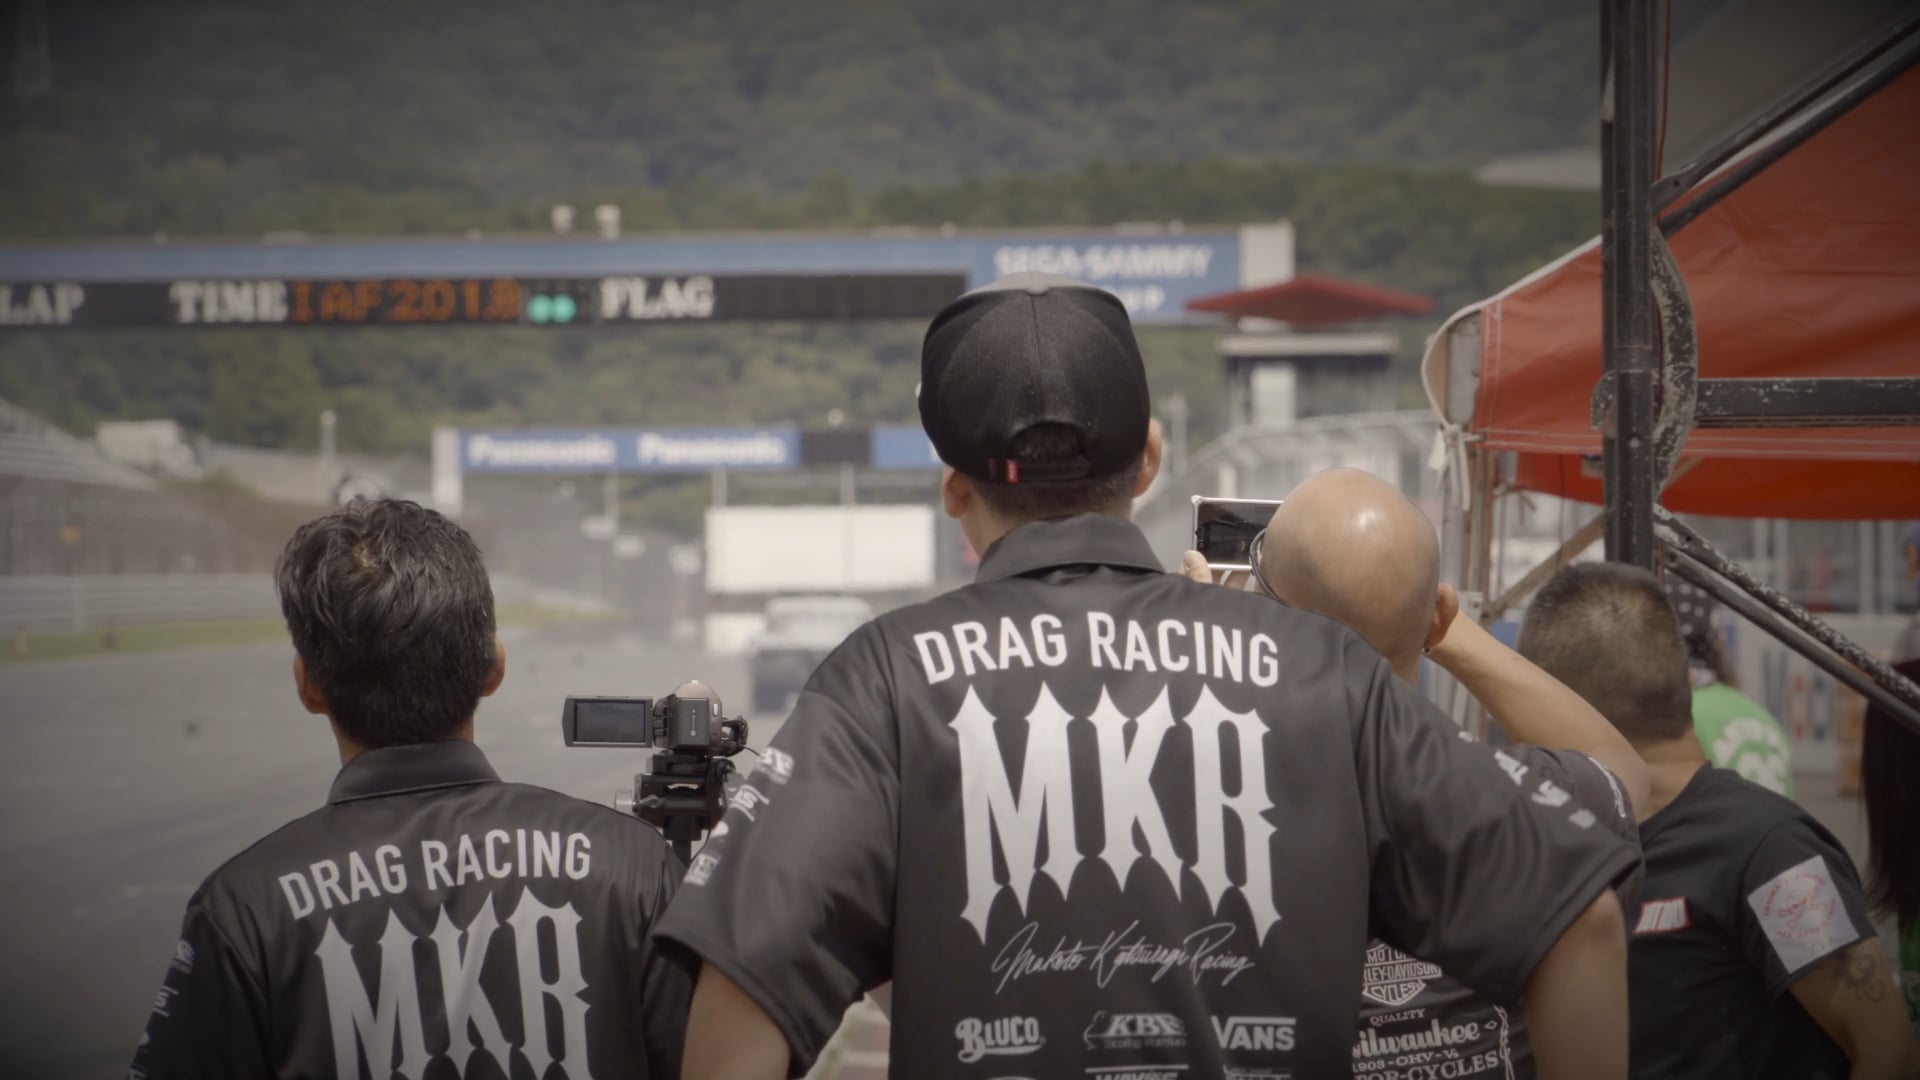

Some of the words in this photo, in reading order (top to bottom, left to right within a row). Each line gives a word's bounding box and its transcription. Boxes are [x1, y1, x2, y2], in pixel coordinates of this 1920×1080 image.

[170, 280, 289, 323] TIME
[600, 276, 715, 320] FLAG
[467, 432, 616, 466] Panasonic
[636, 432, 787, 466] Panasonic
[913, 613, 1068, 685] DRAG
[1086, 611, 1279, 687] RACING
[948, 680, 1282, 948] MKR
[278, 843, 408, 920] DRAG
[421, 829, 592, 890] RACING
[1184, 922, 1255, 987] Racing
[1367, 946, 1416, 964] MOTO
[314, 885, 595, 1080] MKR
[1371, 982, 1416, 1002] CYCLES
[1210, 1016, 1297, 1051] VANS
[1352, 1019, 1480, 1057] ilwaukee
[1370, 1008, 1426, 1026] QUALITY
